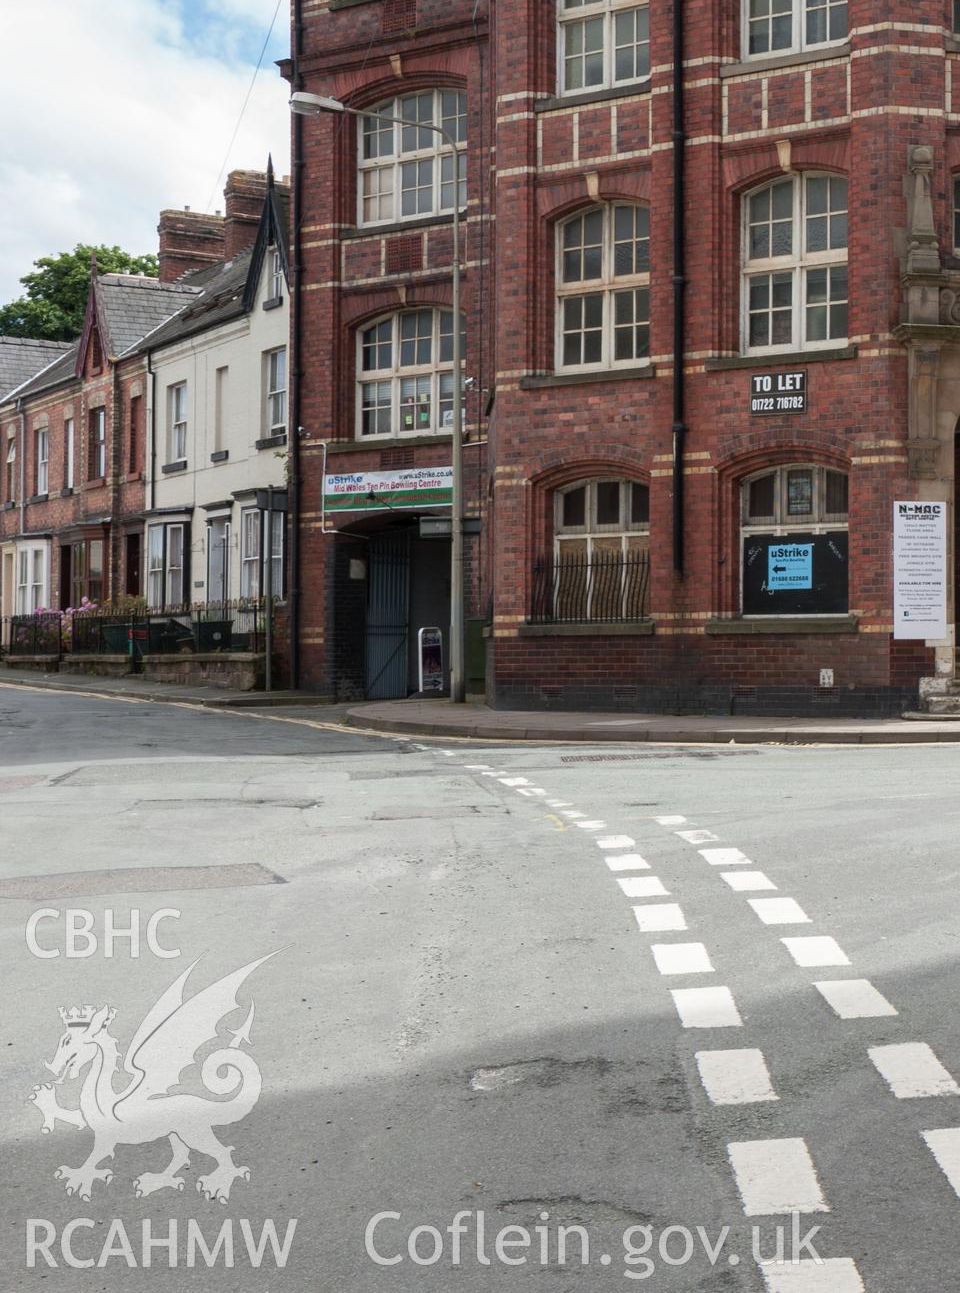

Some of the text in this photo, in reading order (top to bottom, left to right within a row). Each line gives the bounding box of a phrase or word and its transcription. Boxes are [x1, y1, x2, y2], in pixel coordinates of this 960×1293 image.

[754, 374, 803, 392] TO LET
[752, 396, 804, 411] 01722 716782
[328, 474, 363, 484] uStrike
[334, 479, 442, 492] Mid Wales Ten Pin Bowling Centre
[771, 548, 809, 558] uStrike
